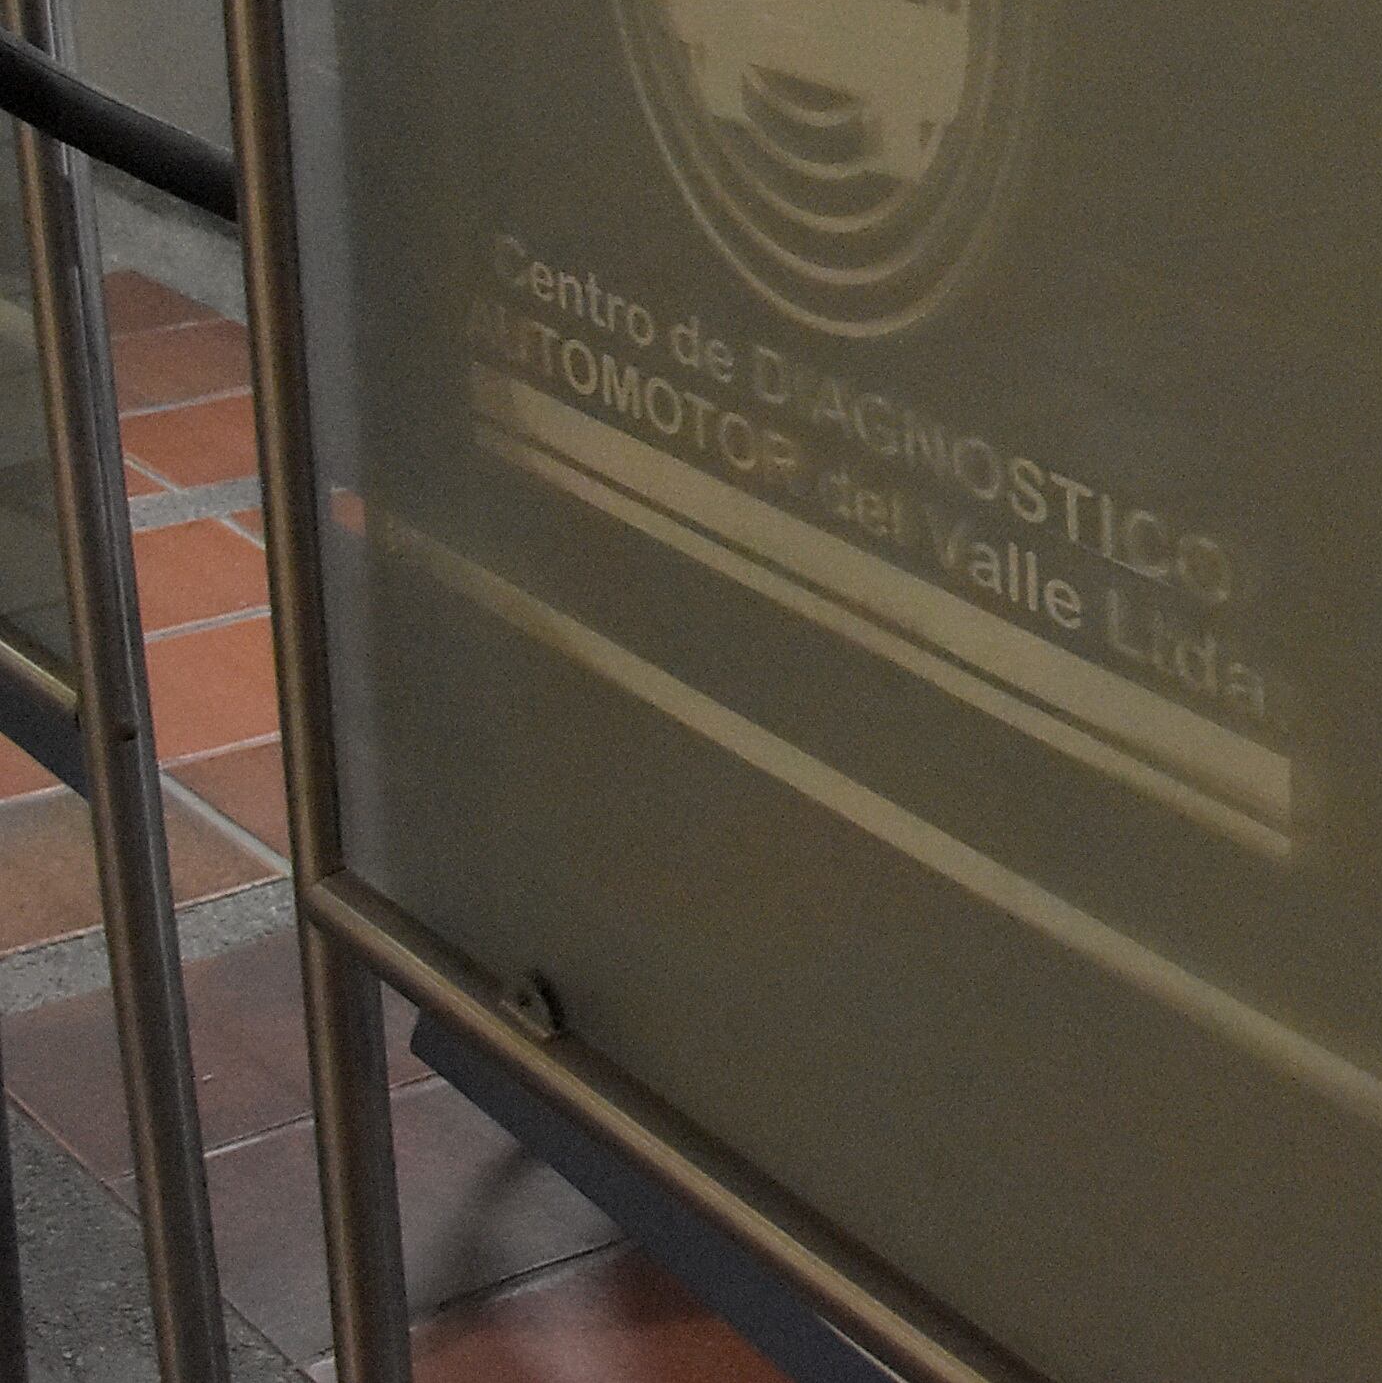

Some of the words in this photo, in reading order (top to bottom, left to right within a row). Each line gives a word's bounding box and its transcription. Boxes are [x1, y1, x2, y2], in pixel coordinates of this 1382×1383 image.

[491, 232, 655, 349] Centro
[669, 315, 736, 385] de
[818, 464, 905, 544] del
[922, 496, 1083, 630] Valle
[1102, 583, 1268, 716] Ltda
